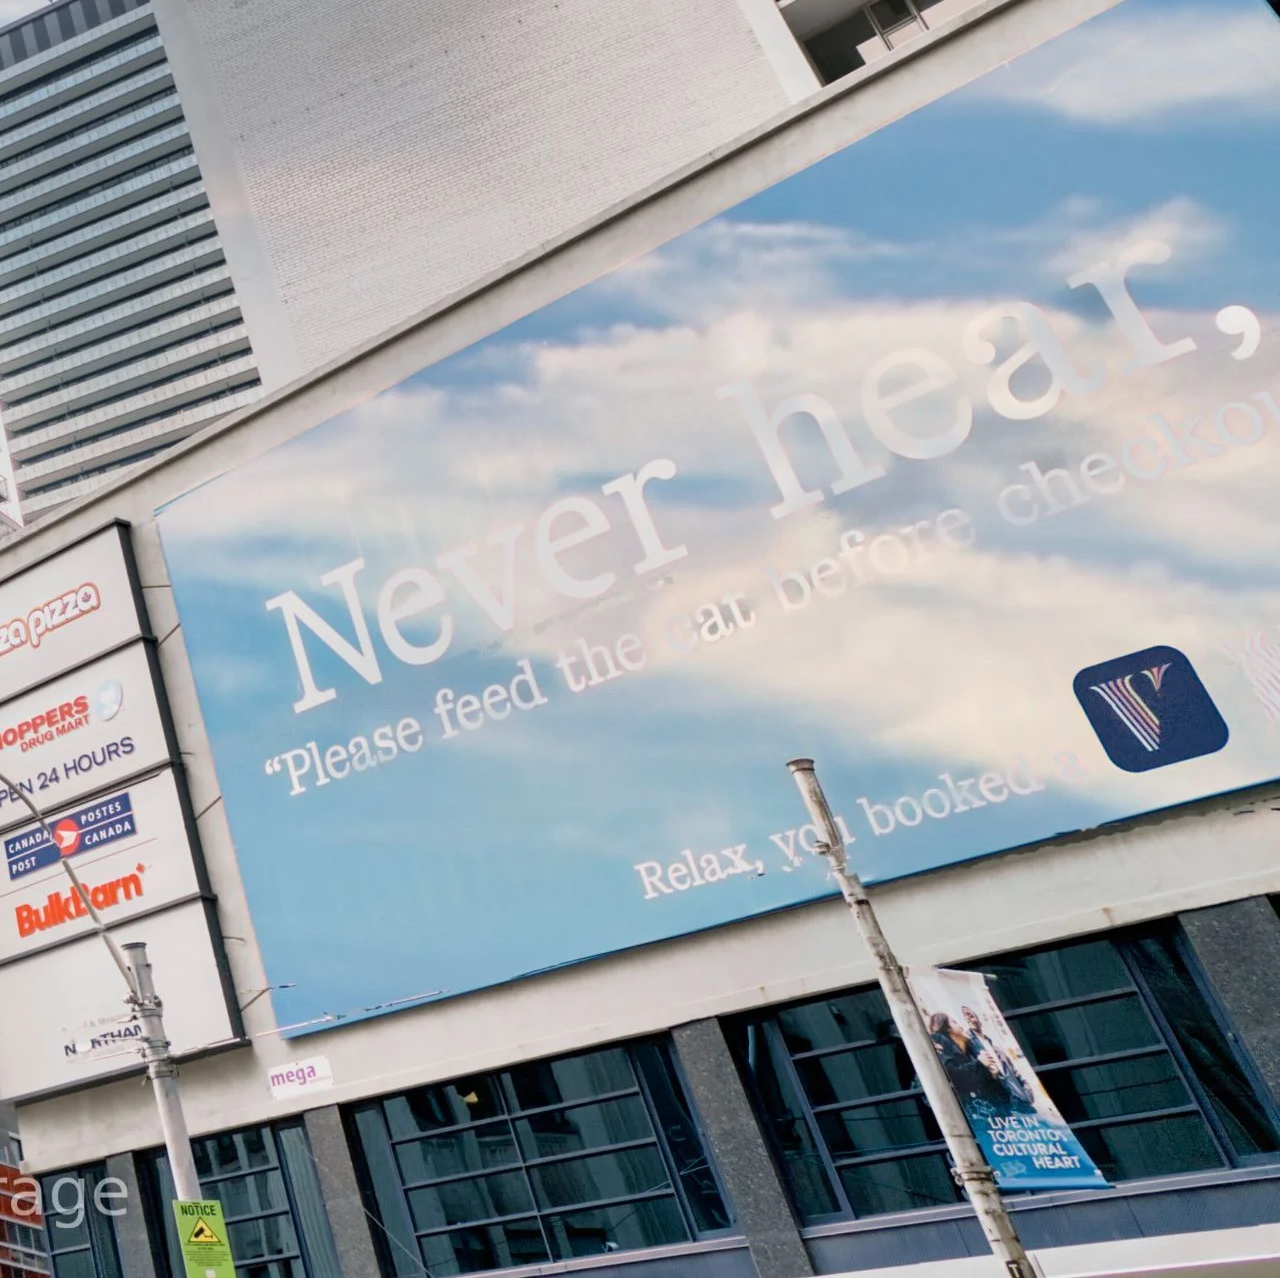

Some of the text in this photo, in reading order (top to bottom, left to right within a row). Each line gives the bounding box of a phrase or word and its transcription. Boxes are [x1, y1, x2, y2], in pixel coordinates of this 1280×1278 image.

[265, 240, 1261, 714] Never hear,
[433, 658, 548, 740] feed
[555, 631, 648, 694] the
[764, 507, 976, 618] before
[997, 386, 1280, 526] checko
[27, 582, 101, 648] pizza
[20, 714, 90, 753] DRUG MART
[37, 767, 60, 790] 24
[63, 736, 135, 779] HOURS
[80, 801, 122, 825] POSTES
[84, 820, 132, 846] CANADA
[635, 841, 764, 901] Relax,
[856, 751, 1046, 837] booked
[8, 829, 50, 854] CANADA
[11, 856, 37, 875] POST
[271, 1065, 316, 1087] mega
[988, 1115, 1040, 1130] LIVE IN
[992, 1143, 1068, 1156] CULTURAL
[1031, 1155, 1081, 1169] HEART
[181, 1204, 217, 1216] NOTICE
